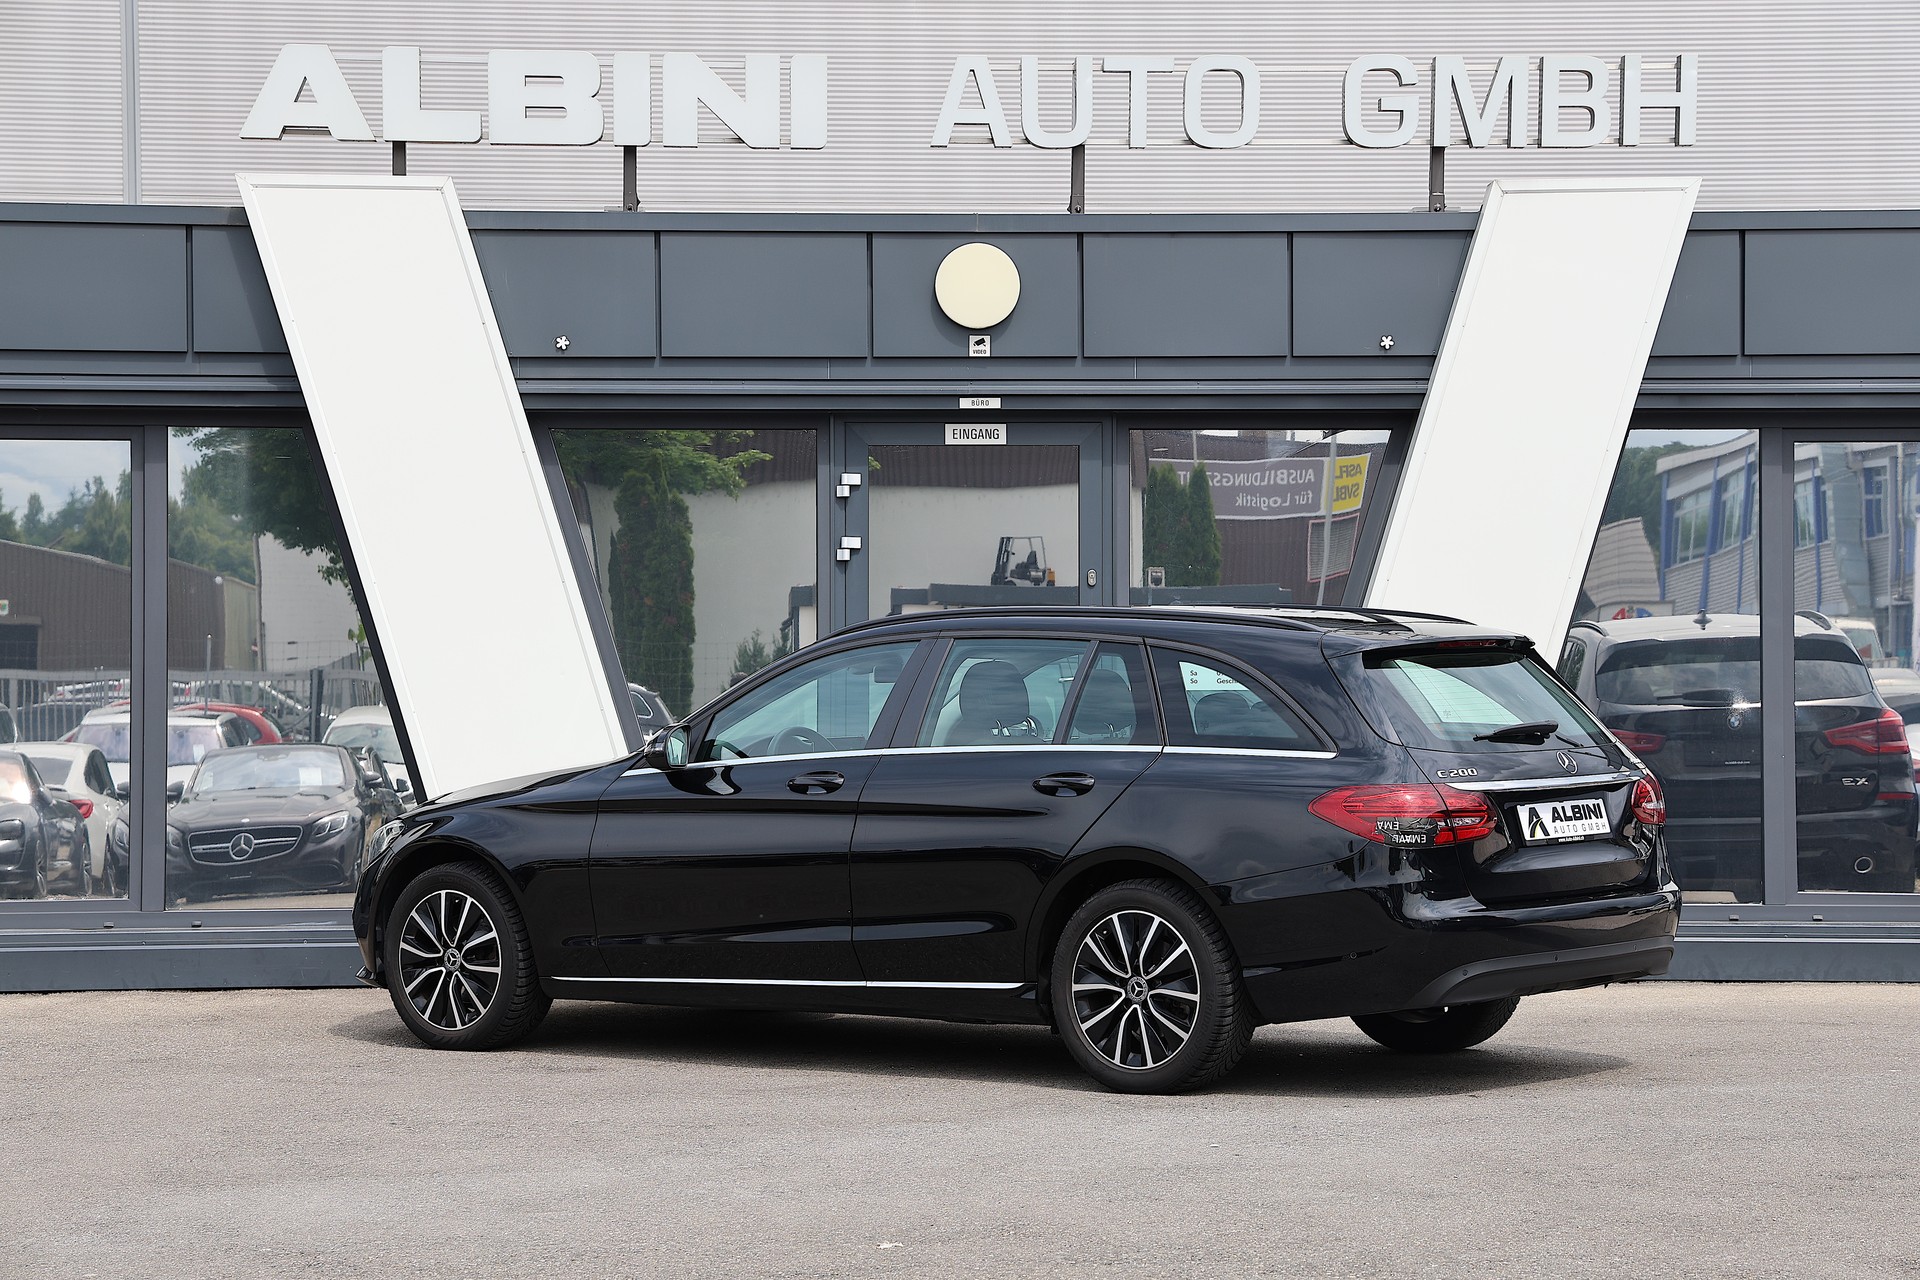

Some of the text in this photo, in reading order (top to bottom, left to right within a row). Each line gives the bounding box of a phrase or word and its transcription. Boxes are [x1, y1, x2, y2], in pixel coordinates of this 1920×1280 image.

[239, 43, 1699, 150] ALBINI AUTO GMBH
[971, 399, 990, 407] BÜRO
[952, 428, 1000, 440] EINGANG
[1436, 767, 1478, 778] C 200
[1552, 803, 1604, 823] ALBINI
[1553, 821, 1607, 834] AUTO GMBH
